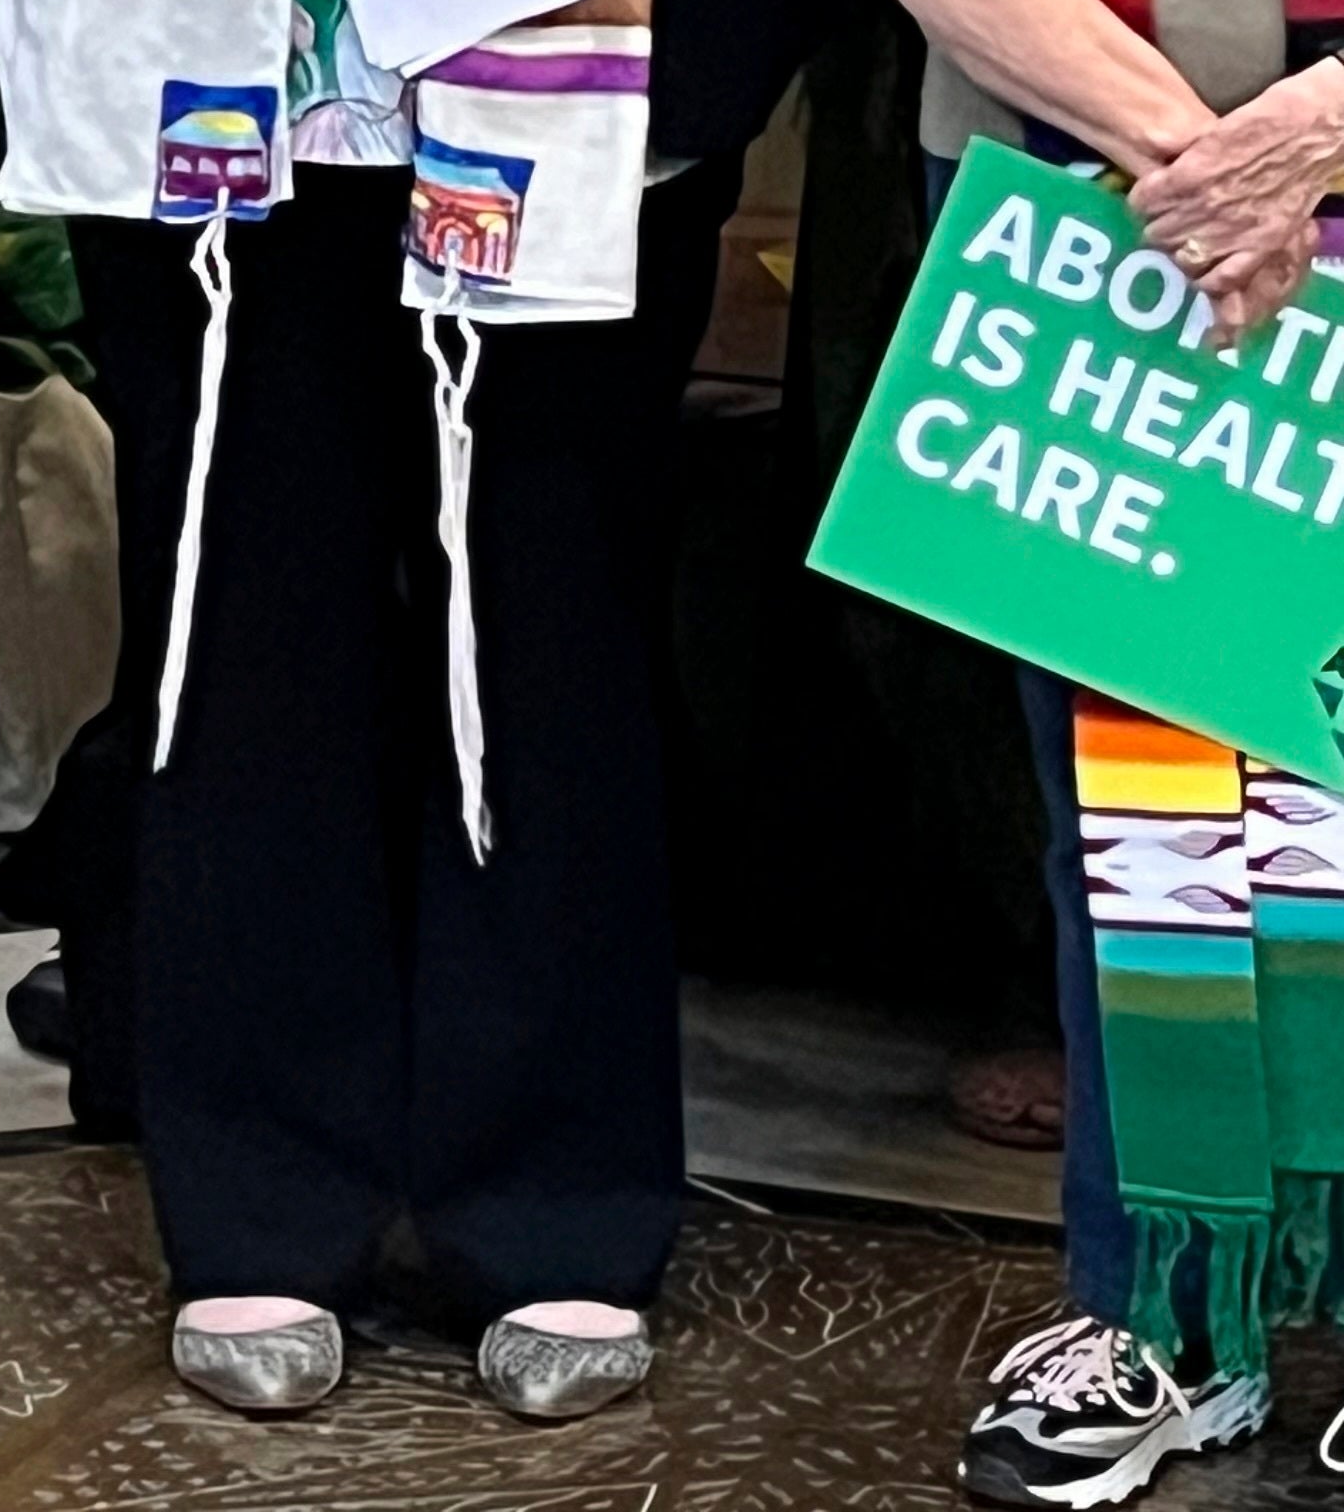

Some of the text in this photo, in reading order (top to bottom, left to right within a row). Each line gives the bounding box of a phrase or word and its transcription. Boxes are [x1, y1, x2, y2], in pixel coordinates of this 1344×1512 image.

[895, 398, 1177, 577] CARE.
[931, 291, 1344, 525] IS HEALT
